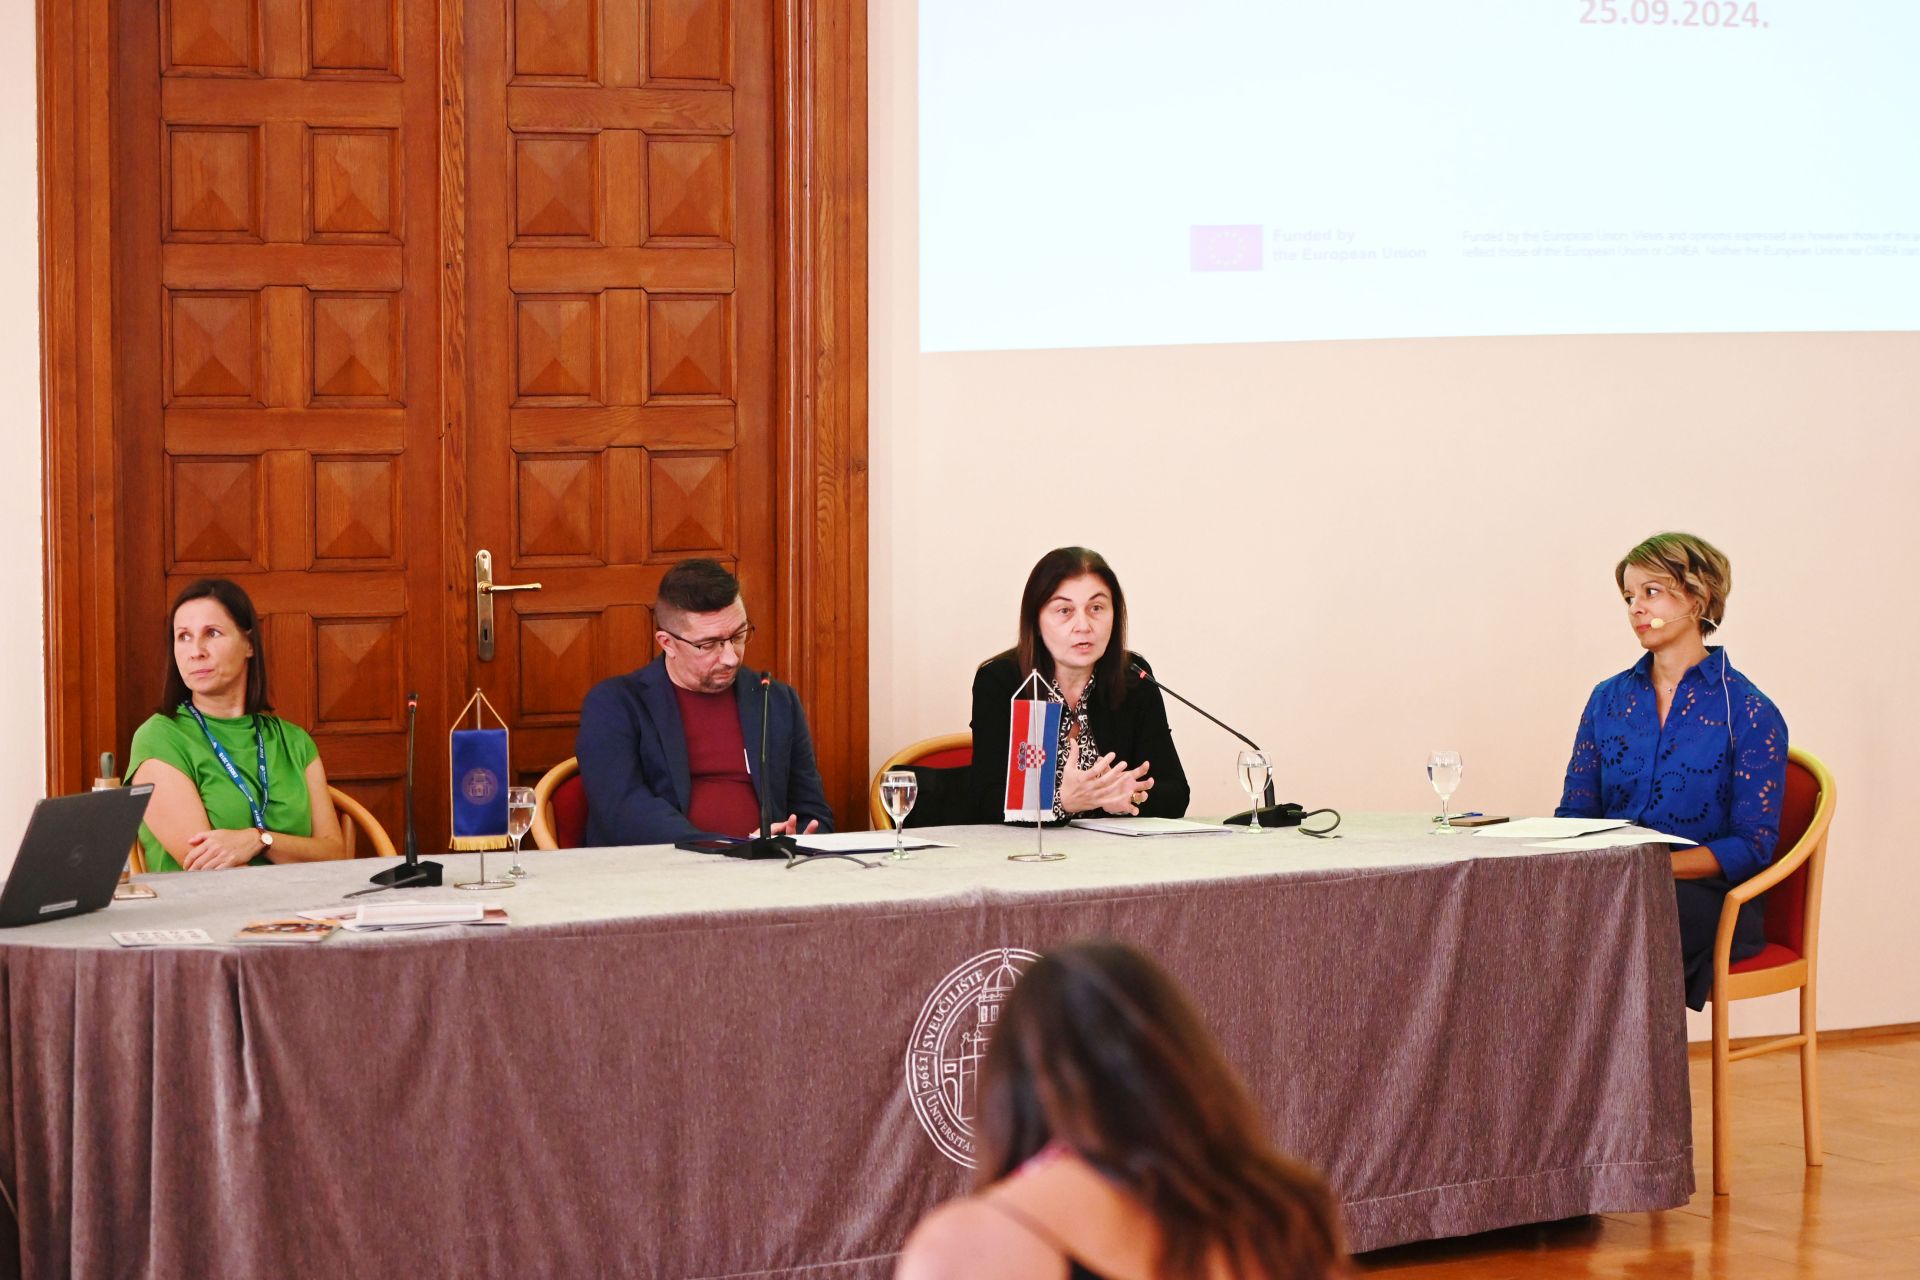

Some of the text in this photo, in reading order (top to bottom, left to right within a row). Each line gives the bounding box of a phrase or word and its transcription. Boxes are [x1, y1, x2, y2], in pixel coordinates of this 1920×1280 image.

[1579, 0, 1769, 28] 25.09.2024.
[1272, 228, 1356, 244] Funded by
[1272, 247, 1427, 263] the European Union
[922, 969, 985, 1049] SVEUČILIŠTE
[916, 1056, 934, 1089] 1396
